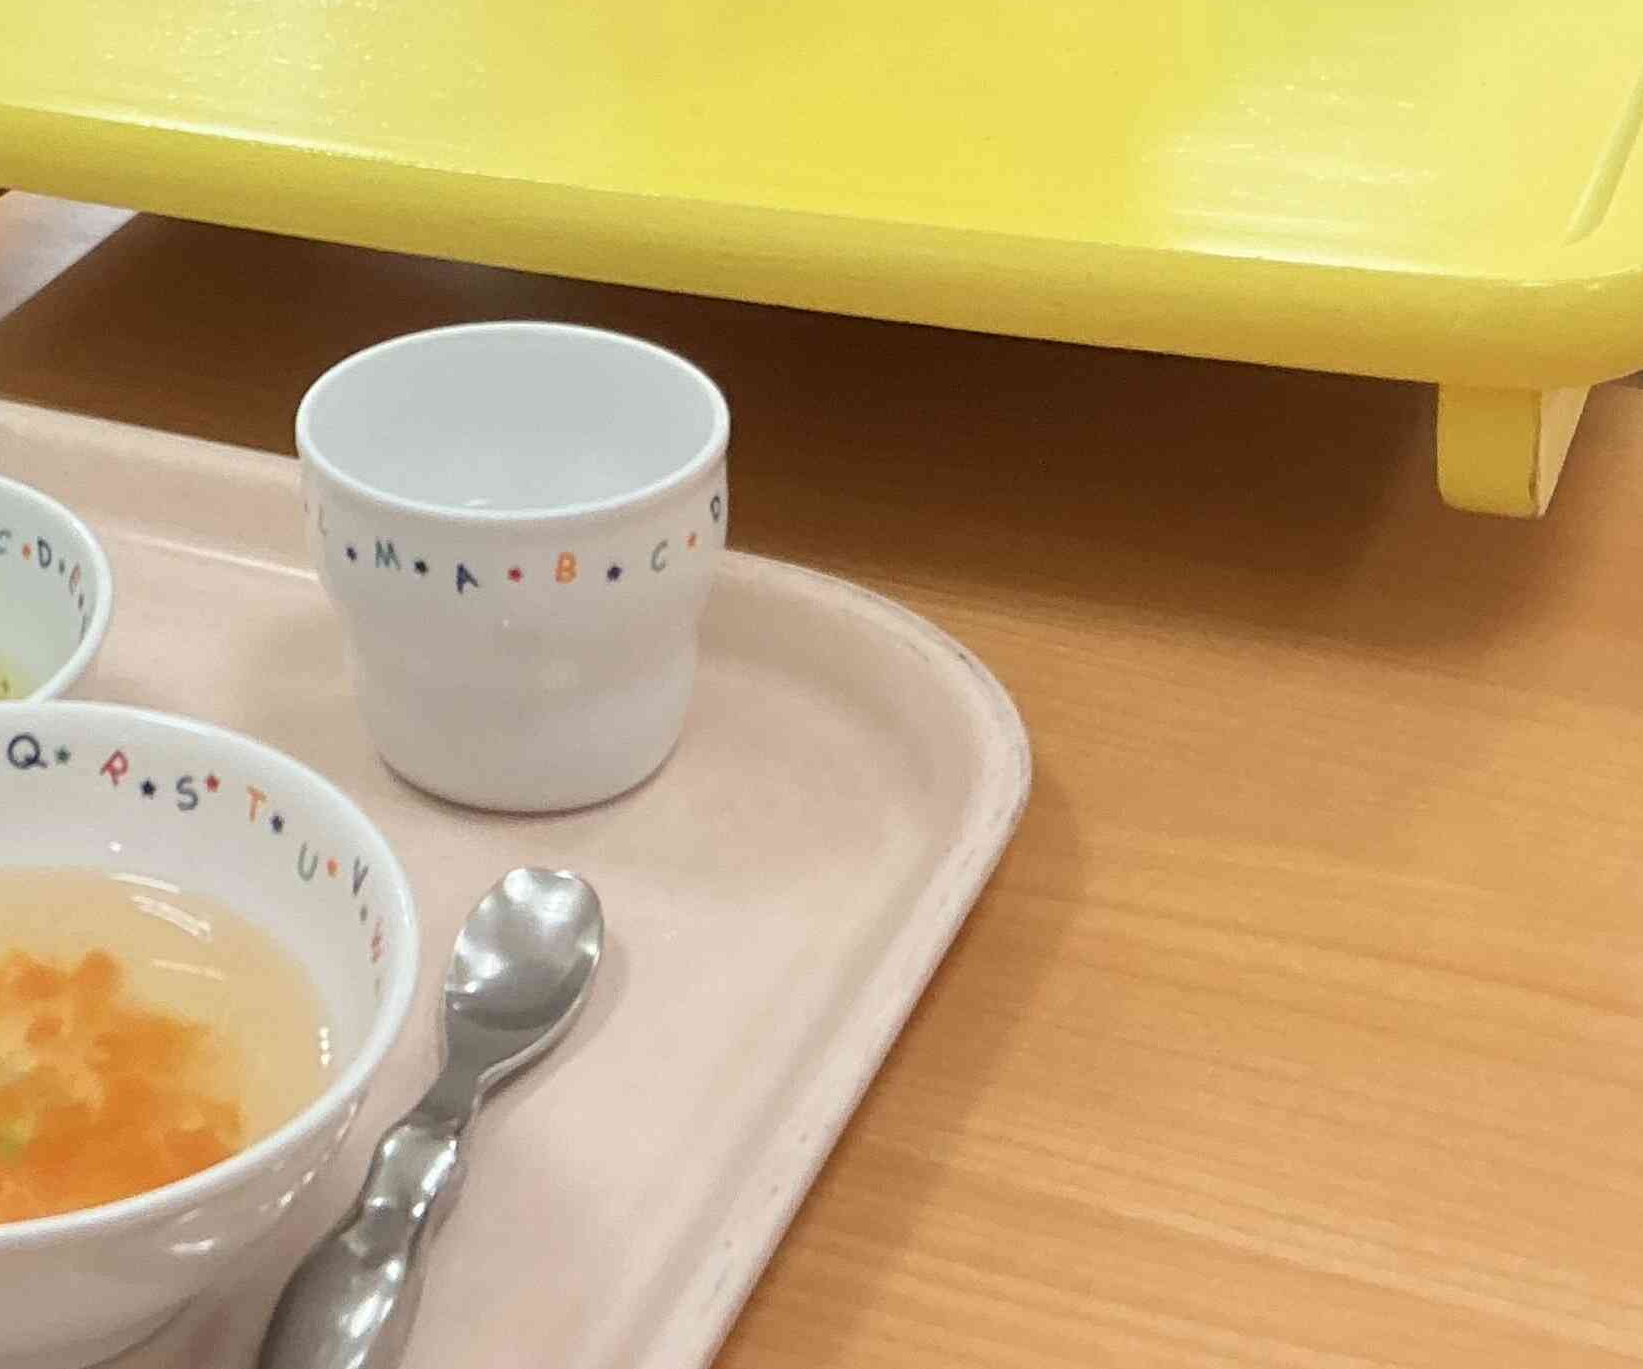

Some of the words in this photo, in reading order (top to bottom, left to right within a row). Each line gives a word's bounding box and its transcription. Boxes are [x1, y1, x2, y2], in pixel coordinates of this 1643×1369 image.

[37, 537, 52, 568] D
[375, 540, 400, 570] M
[455, 563, 480, 594] A
[555, 552, 577, 584] B
[651, 540, 668, 572] C
[7, 734, 47, 769] Q
[100, 750, 128, 786] R
[176, 775, 198, 811] S
[246, 786, 267, 822] T
[297, 842, 318, 881] U
[352, 856, 368, 896] V
